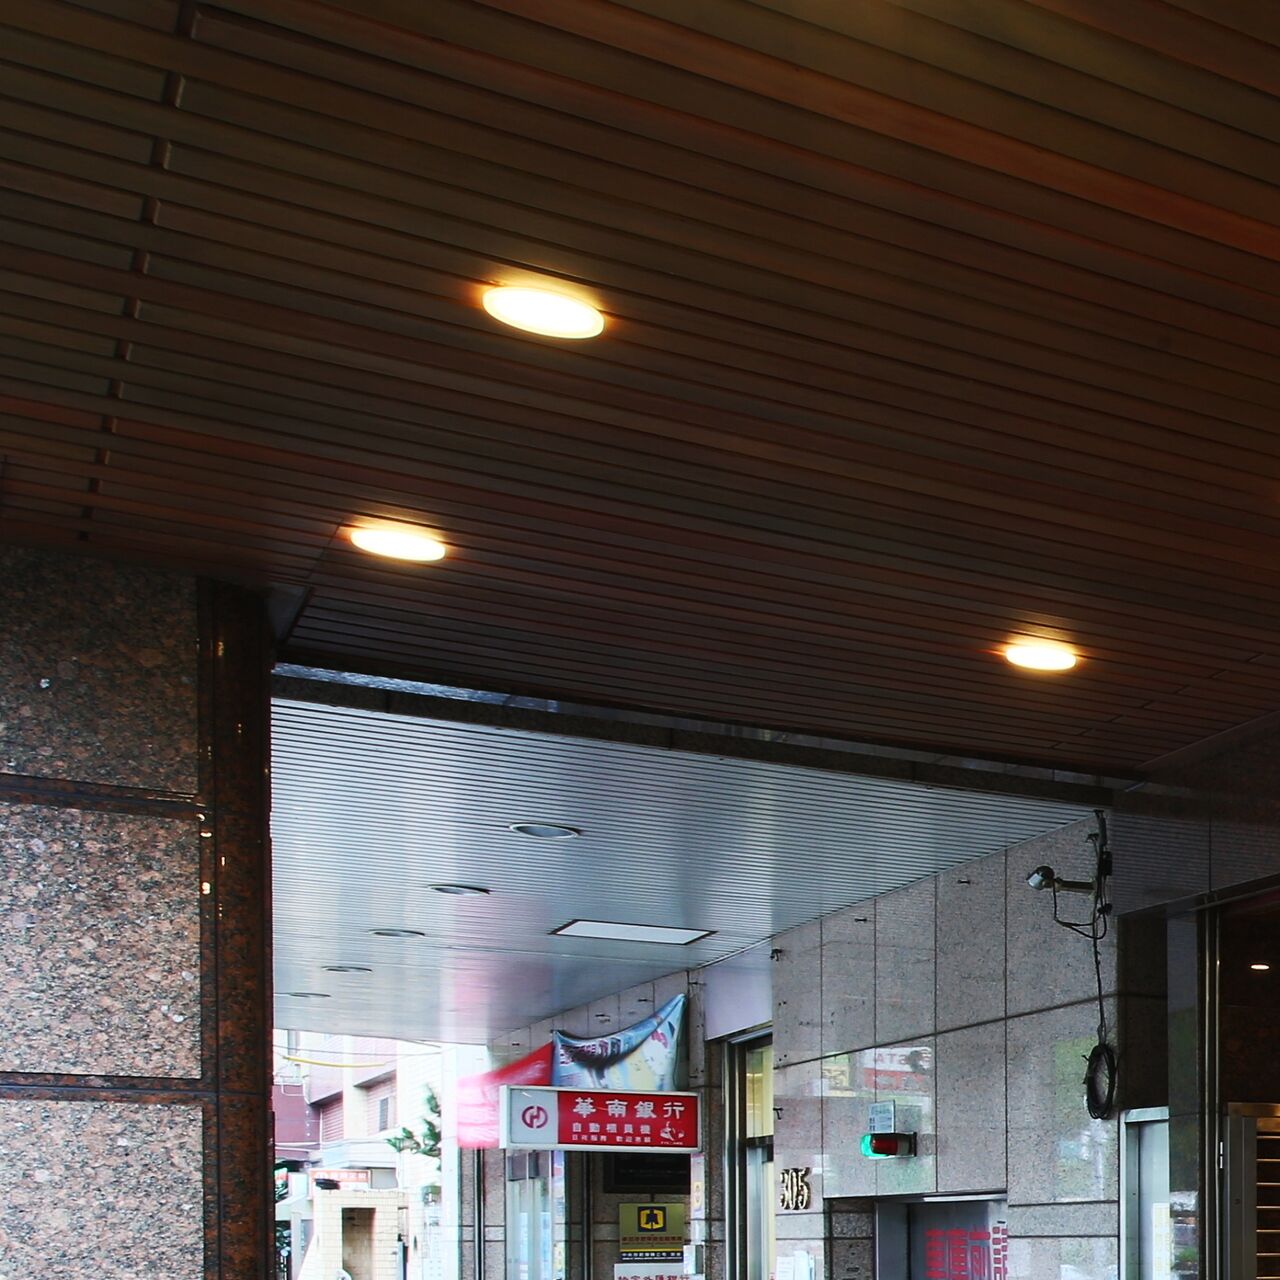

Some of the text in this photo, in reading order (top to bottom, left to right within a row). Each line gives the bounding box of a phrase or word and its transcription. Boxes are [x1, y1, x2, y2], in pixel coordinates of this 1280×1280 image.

[572, 1096, 686, 1120] 華南銀行
[779, 1167, 811, 1210] 305
